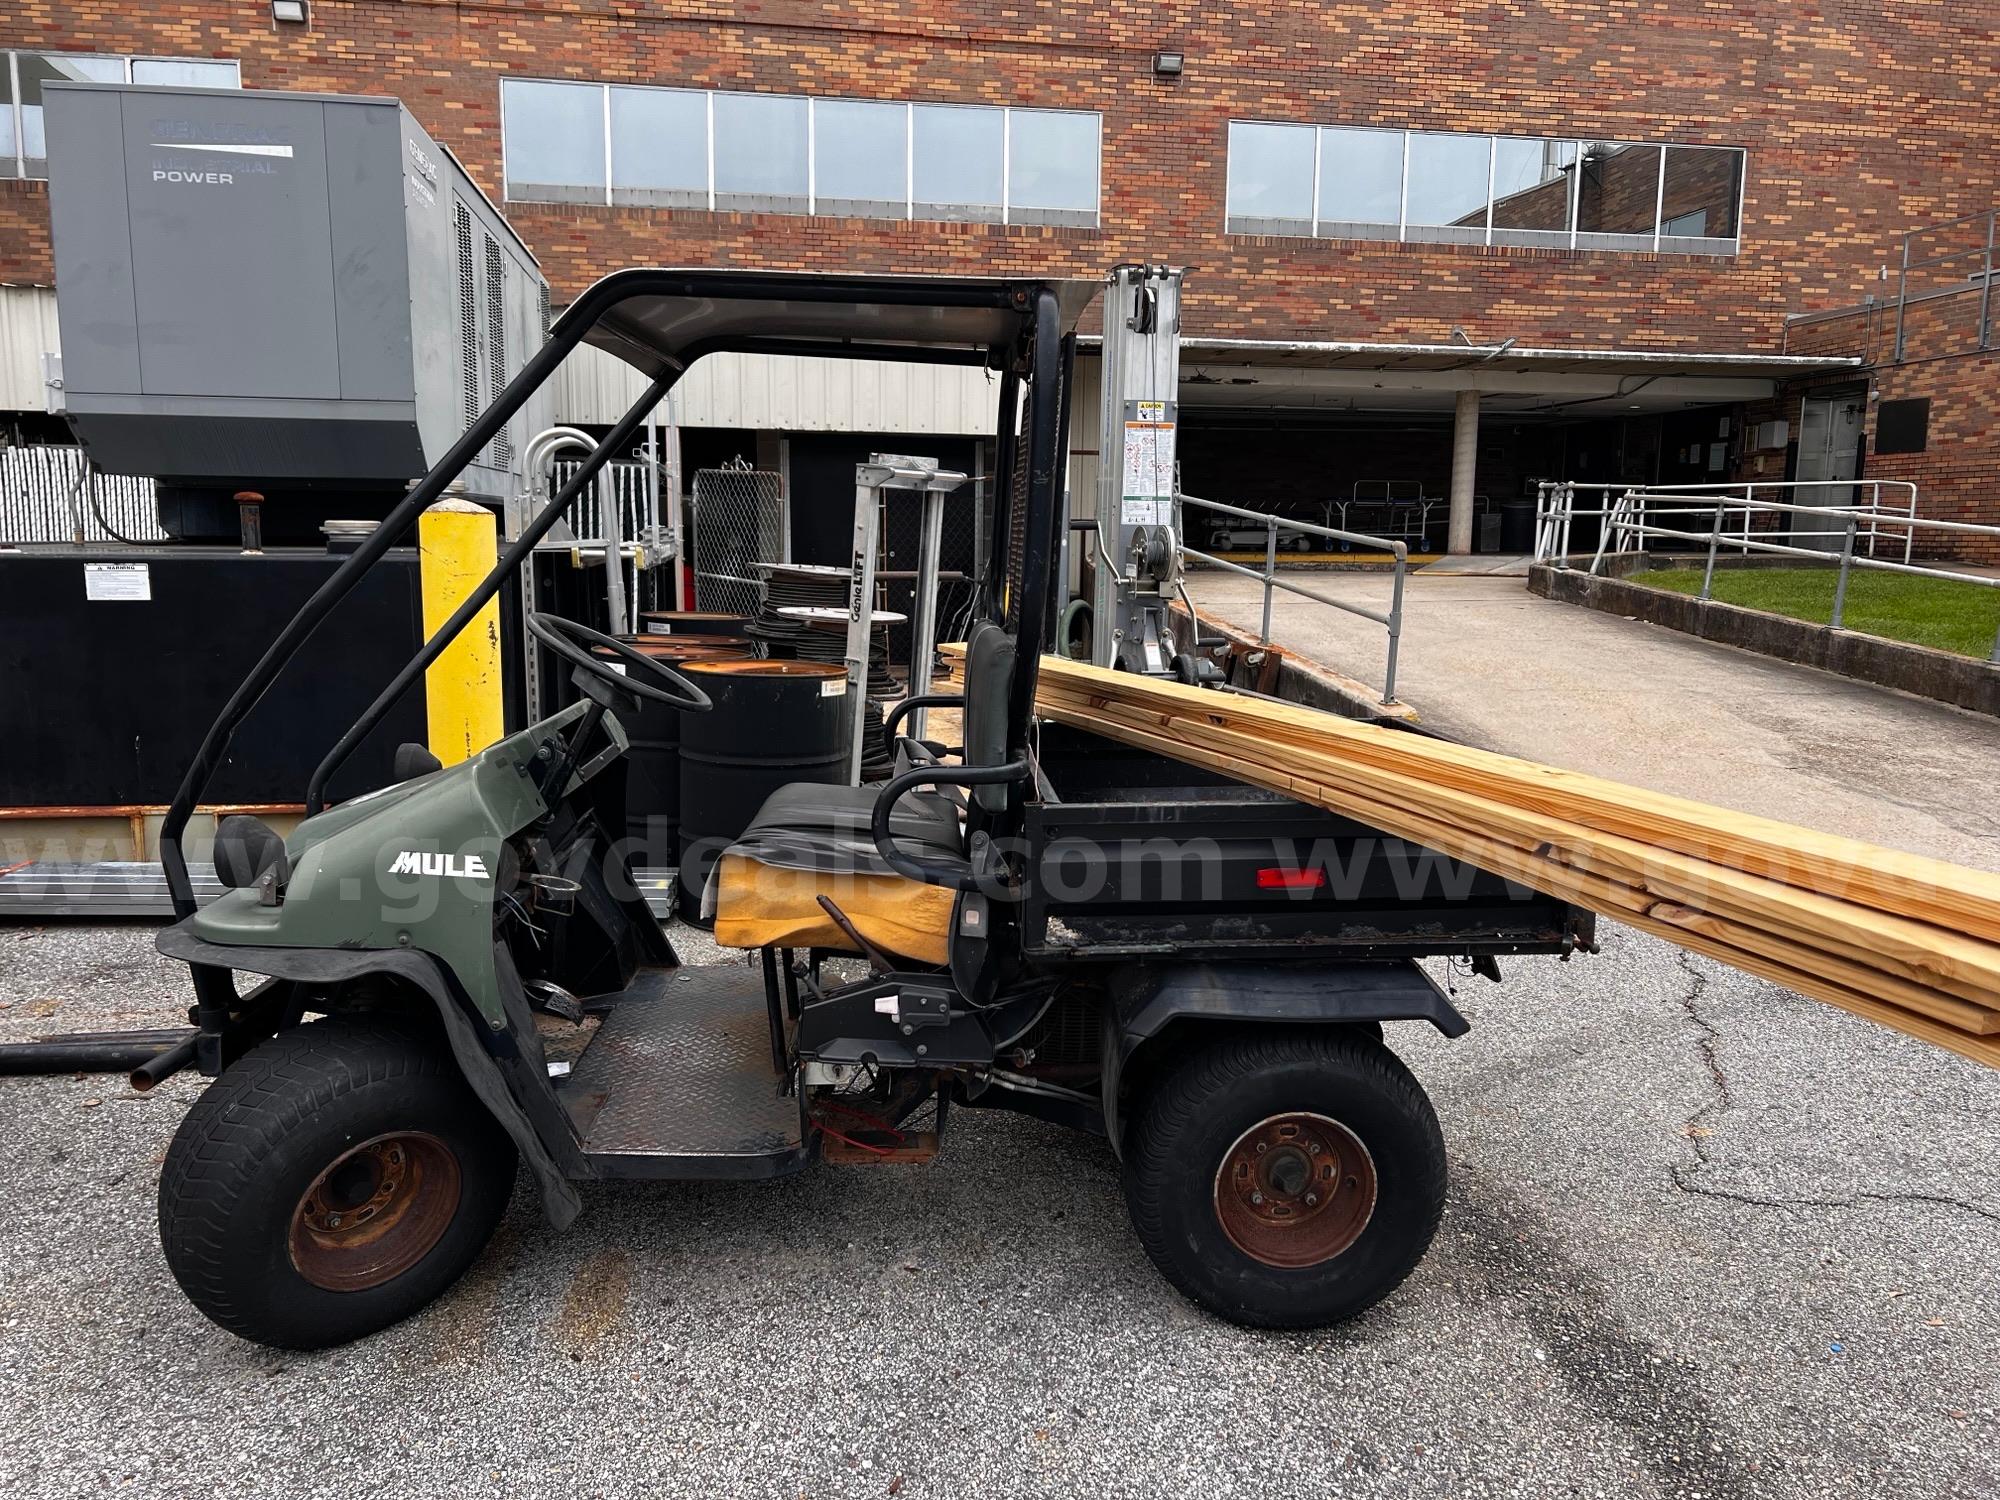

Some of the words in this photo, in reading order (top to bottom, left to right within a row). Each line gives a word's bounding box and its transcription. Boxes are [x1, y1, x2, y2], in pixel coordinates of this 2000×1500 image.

[152, 170, 234, 185] POWER
[853, 551, 865, 586] LIFT
[851, 587, 862, 622] Genie
[387, 851, 490, 879] MULE
